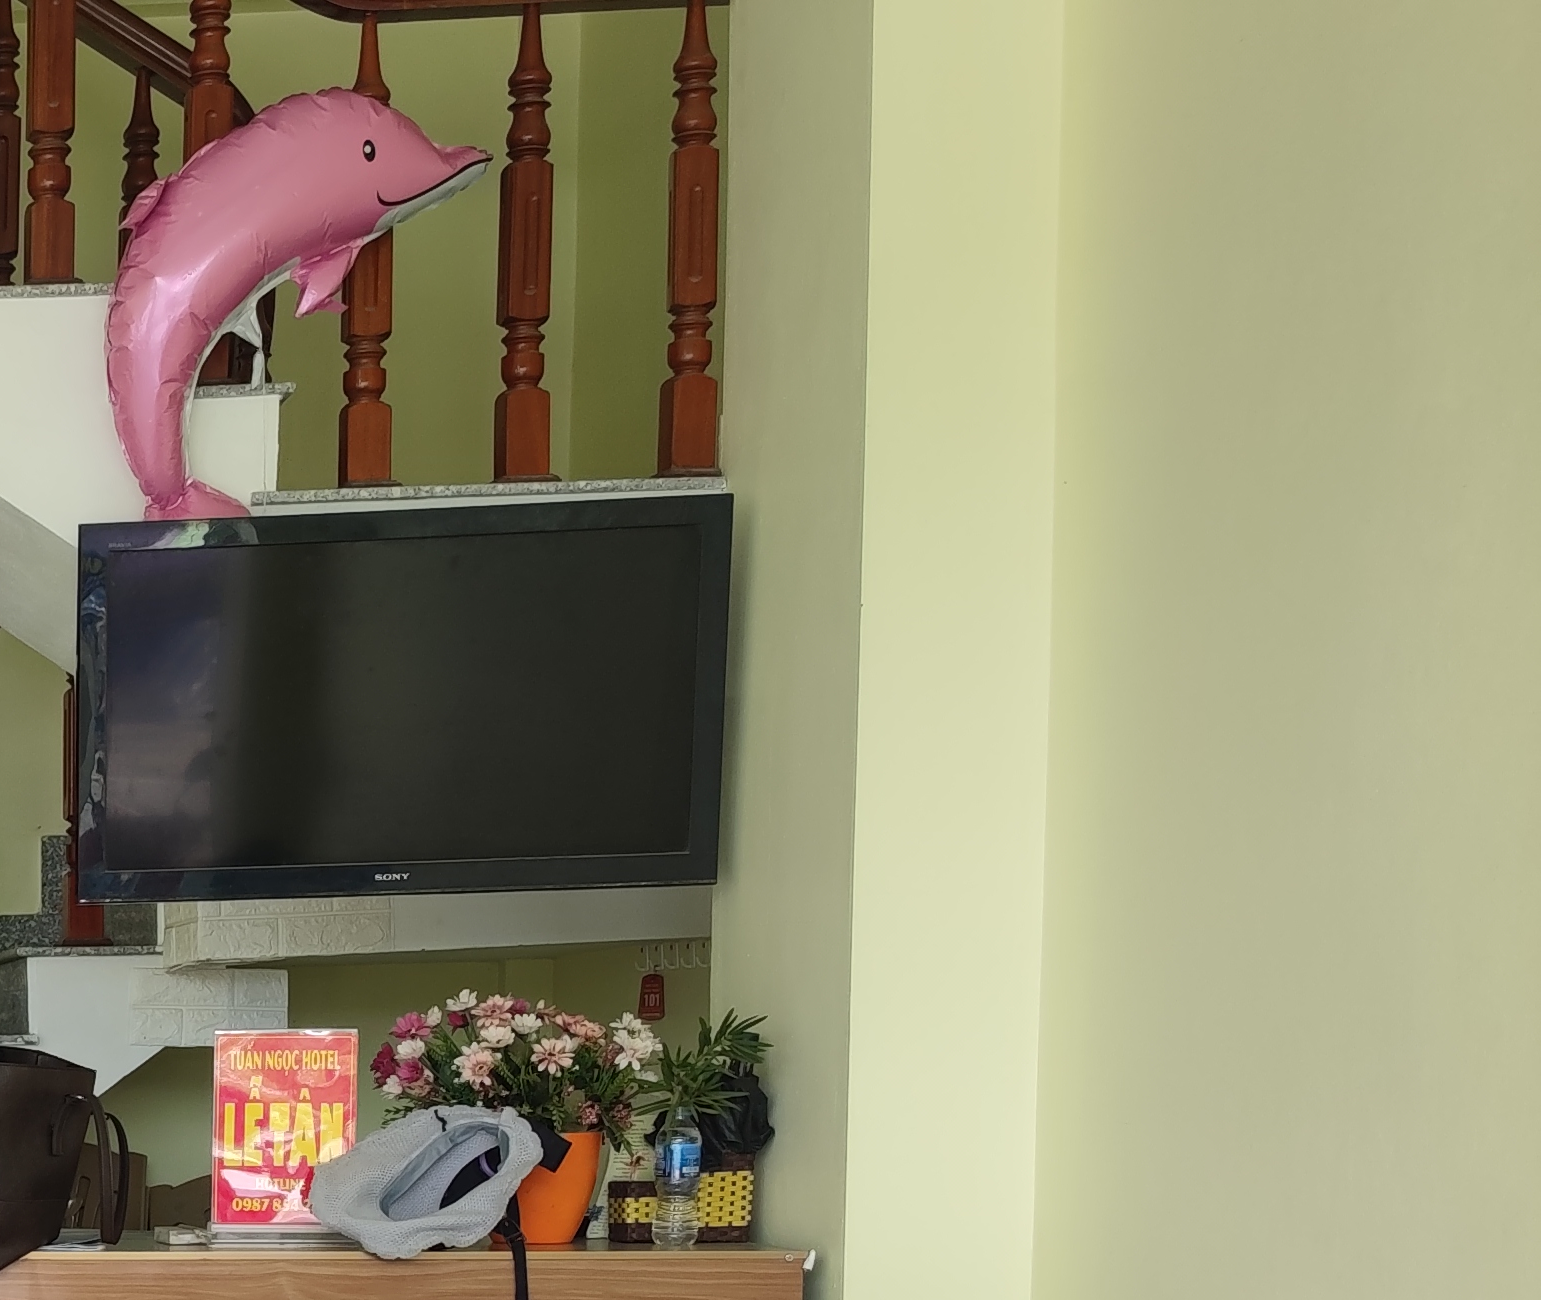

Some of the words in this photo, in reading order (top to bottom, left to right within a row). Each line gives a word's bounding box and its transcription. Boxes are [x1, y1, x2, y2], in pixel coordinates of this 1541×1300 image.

[374, 872, 411, 881] SONY
[644, 993, 660, 1007] 101
[265, 1049, 299, 1076] NGỌC
[303, 1049, 341, 1071] HOTEL
[269, 1087, 344, 1167] TÂN
[255, 1178, 307, 1191] HOTLINE
[232, 1197, 270, 1212] 0987
